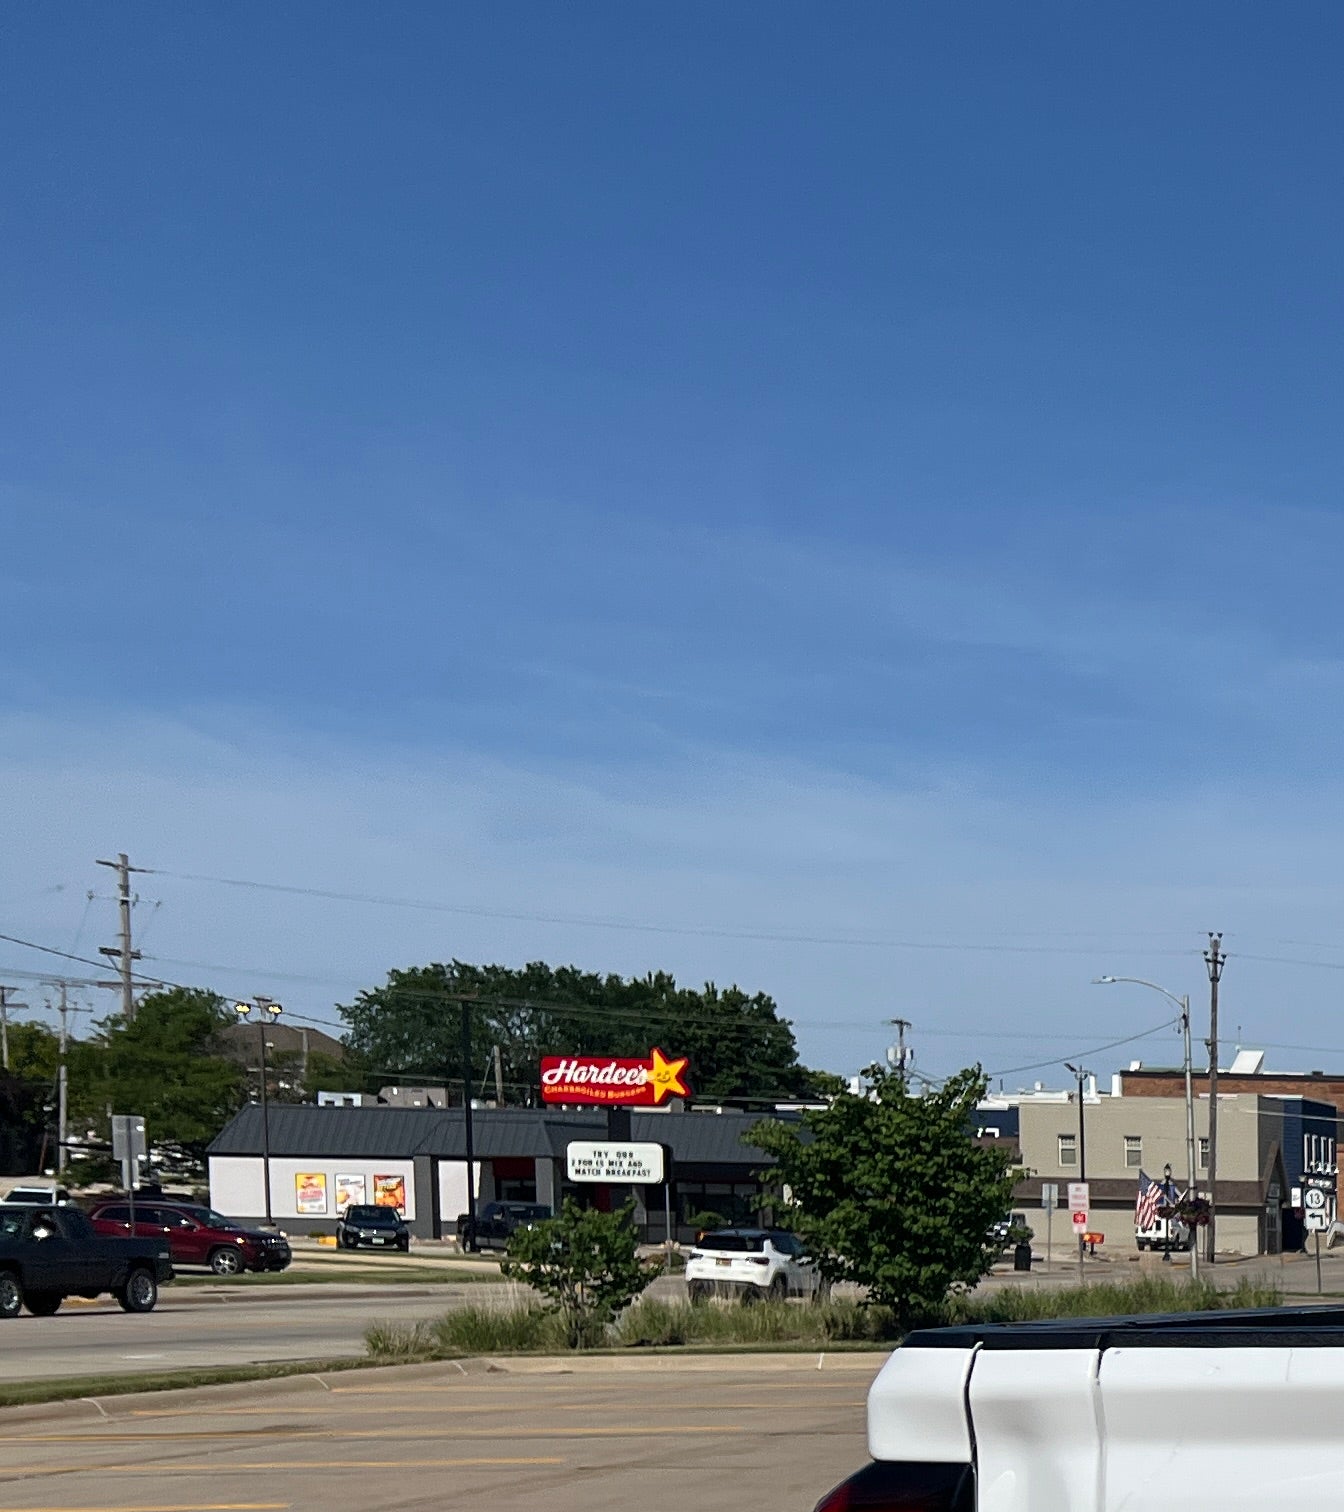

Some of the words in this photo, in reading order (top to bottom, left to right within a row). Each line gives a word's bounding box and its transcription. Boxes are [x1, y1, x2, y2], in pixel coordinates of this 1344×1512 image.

[542, 1059, 648, 1086] Hardee's
[574, 1168, 601, 1176] MATCH
[605, 1168, 651, 1177] BREAKFAST
[1310, 1193, 1320, 1204] 13
